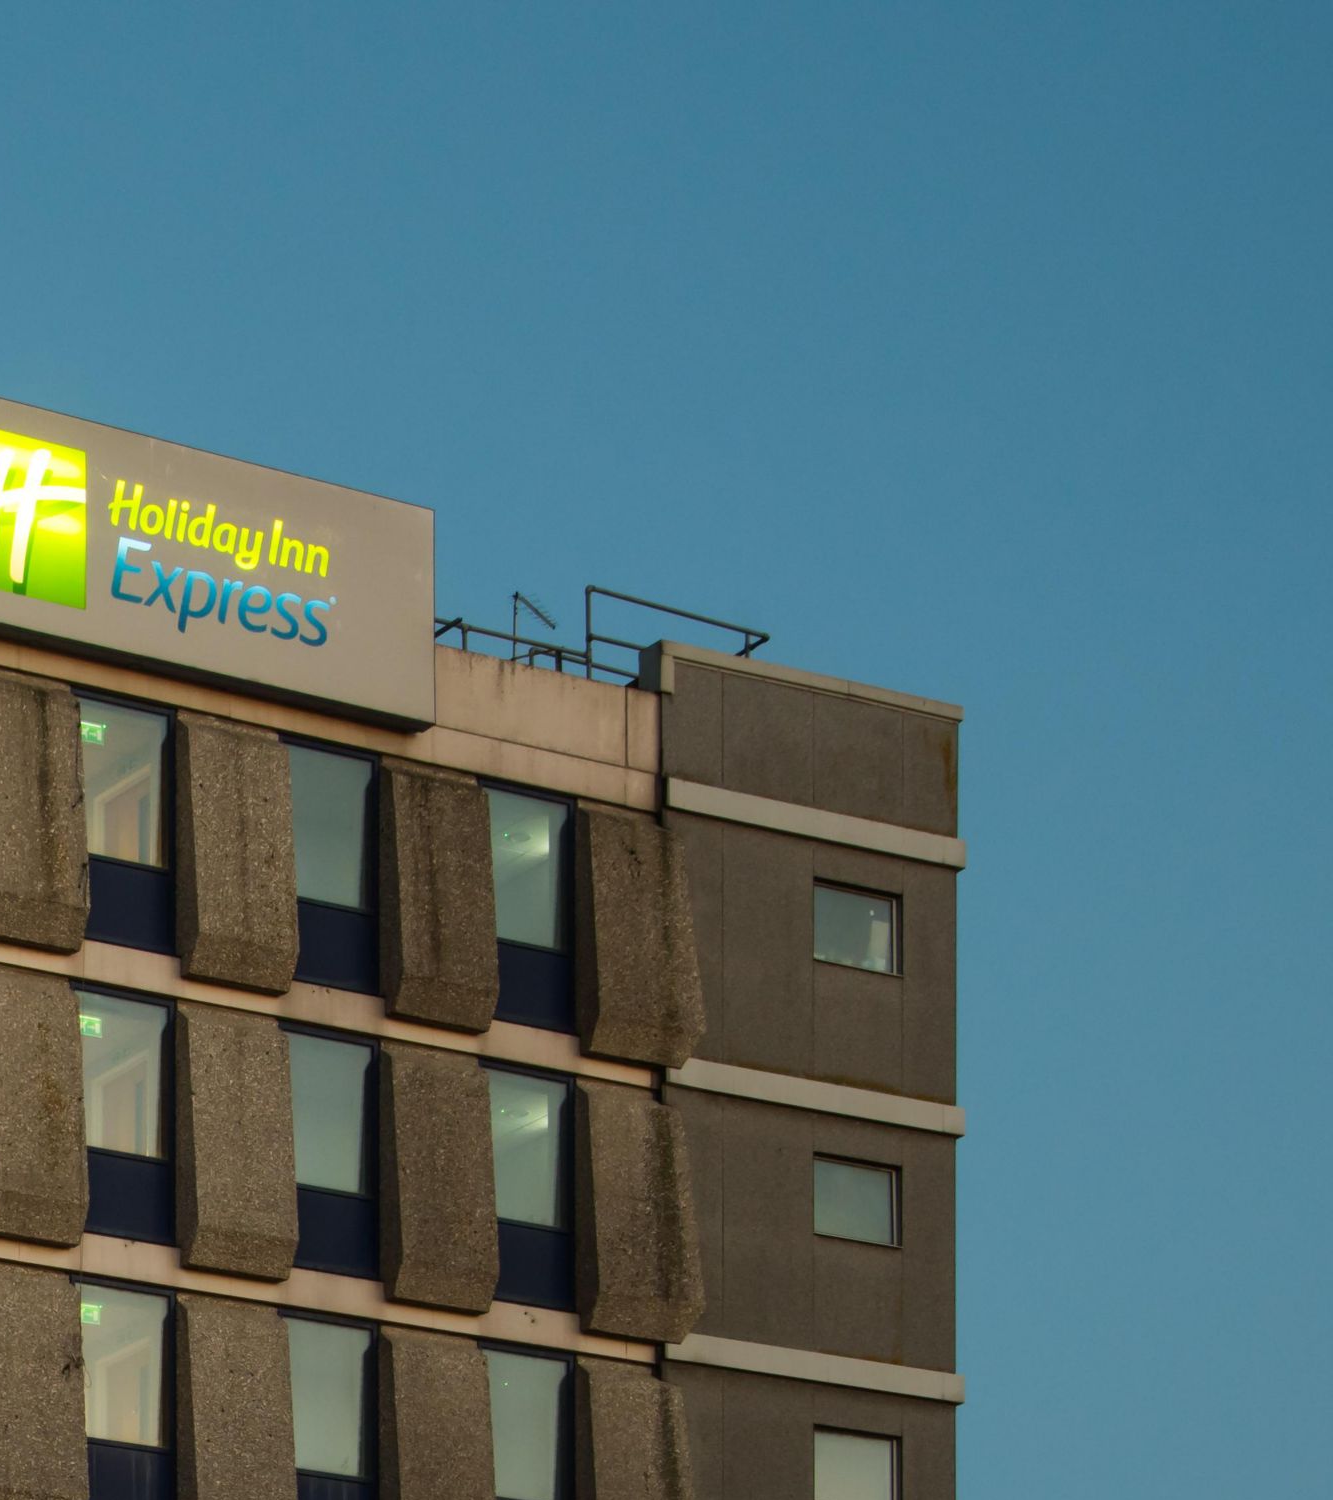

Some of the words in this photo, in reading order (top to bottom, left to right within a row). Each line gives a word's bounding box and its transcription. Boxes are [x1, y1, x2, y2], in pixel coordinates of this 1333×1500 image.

[108, 479, 264, 571] Holiday
[268, 519, 330, 578] Inn
[110, 536, 331, 648] Express
